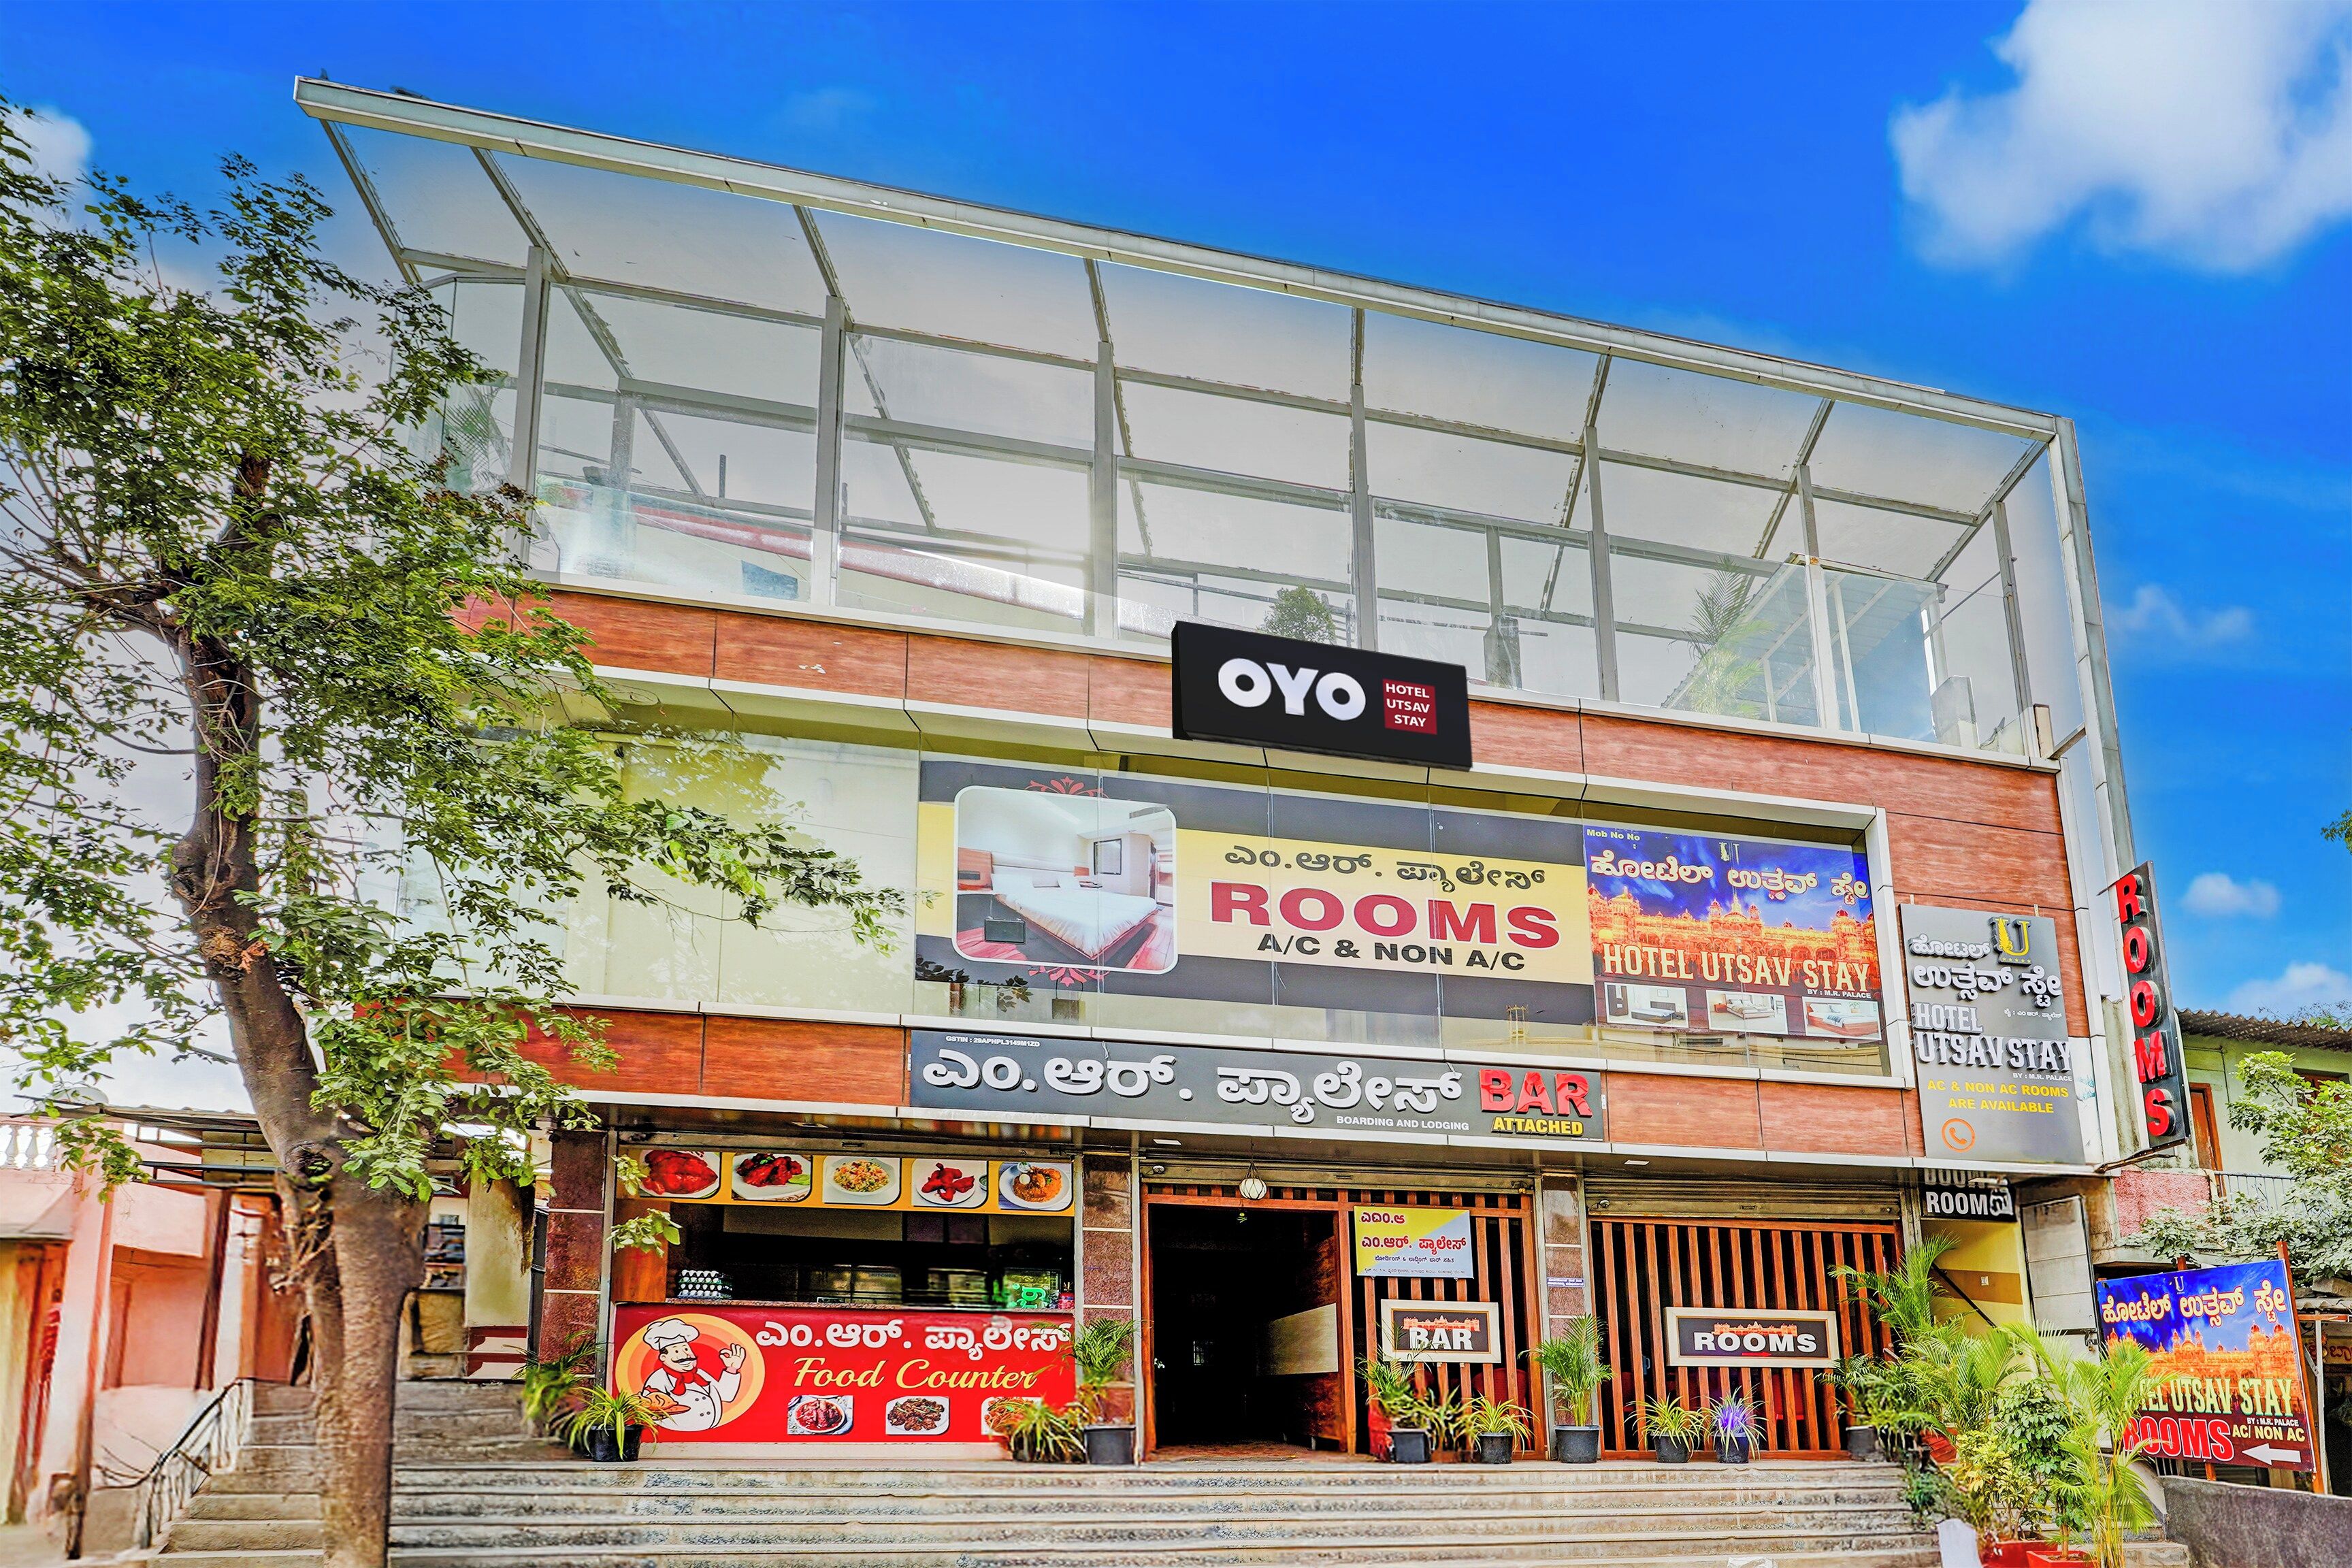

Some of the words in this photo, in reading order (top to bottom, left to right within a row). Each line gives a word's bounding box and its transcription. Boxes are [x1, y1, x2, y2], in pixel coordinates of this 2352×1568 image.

[1218, 657, 1366, 721] OYO
[1386, 683, 1430, 698] HOTEL
[1386, 700, 1431, 713] UTSAV
[1394, 714, 1426, 727] STAY
[1586, 829, 1607, 838] Mob
[1610, 831, 1624, 839] No
[1627, 833, 1640, 841] No
[1211, 881, 1561, 948] ROOMS
[1257, 933, 1321, 956] A/C
[1335, 939, 1361, 958] &
[1375, 942, 1453, 965] NON
[1465, 949, 1525, 971] A/C
[1603, 943, 1694, 979] HOTEL
[1700, 951, 1793, 987] UTSAV
[1802, 959, 1870, 992] STAY
[1915, 1002, 1982, 1032] HOTEL
[2116, 873, 2173, 1137] ROOMS
[1915, 1031, 2004, 1066] UTSAV
[2007, 1039, 2072, 1071] STAY
[1216, 1060, 1463, 1124] ಪ್ಯಾಲೇಸ್
[1479, 1068, 1592, 1117] BAR
[1927, 1079, 1946, 1091] AC
[1951, 1081, 1961, 1092] &
[1965, 1082, 1995, 1094] NON
[1999, 1083, 2017, 1095] AC
[2021, 1085, 2069, 1098] ROOMS
[1948, 1098, 1976, 1110] ARE
[1980, 1098, 2054, 1113] AVAILABLE
[1336, 1115, 1394, 1128] BOARDING
[1396, 1118, 1419, 1128] AND
[1420, 1120, 1469, 1130] LODGING
[1492, 1116, 1584, 1136] ATTACHED
[1409, 1326, 1473, 1350] BAR
[1693, 1332, 1817, 1353] ROOMS
[793, 1357, 887, 1388] Food
[896, 1358, 1039, 1389] Counter
[2170, 1377, 2233, 1414] UTSAV
[2238, 1377, 2293, 1417] STAY
[2122, 1416, 2234, 1461] ROOMS
[2254, 1426, 2283, 1441] NON
[2287, 1428, 2305, 1442] AC
